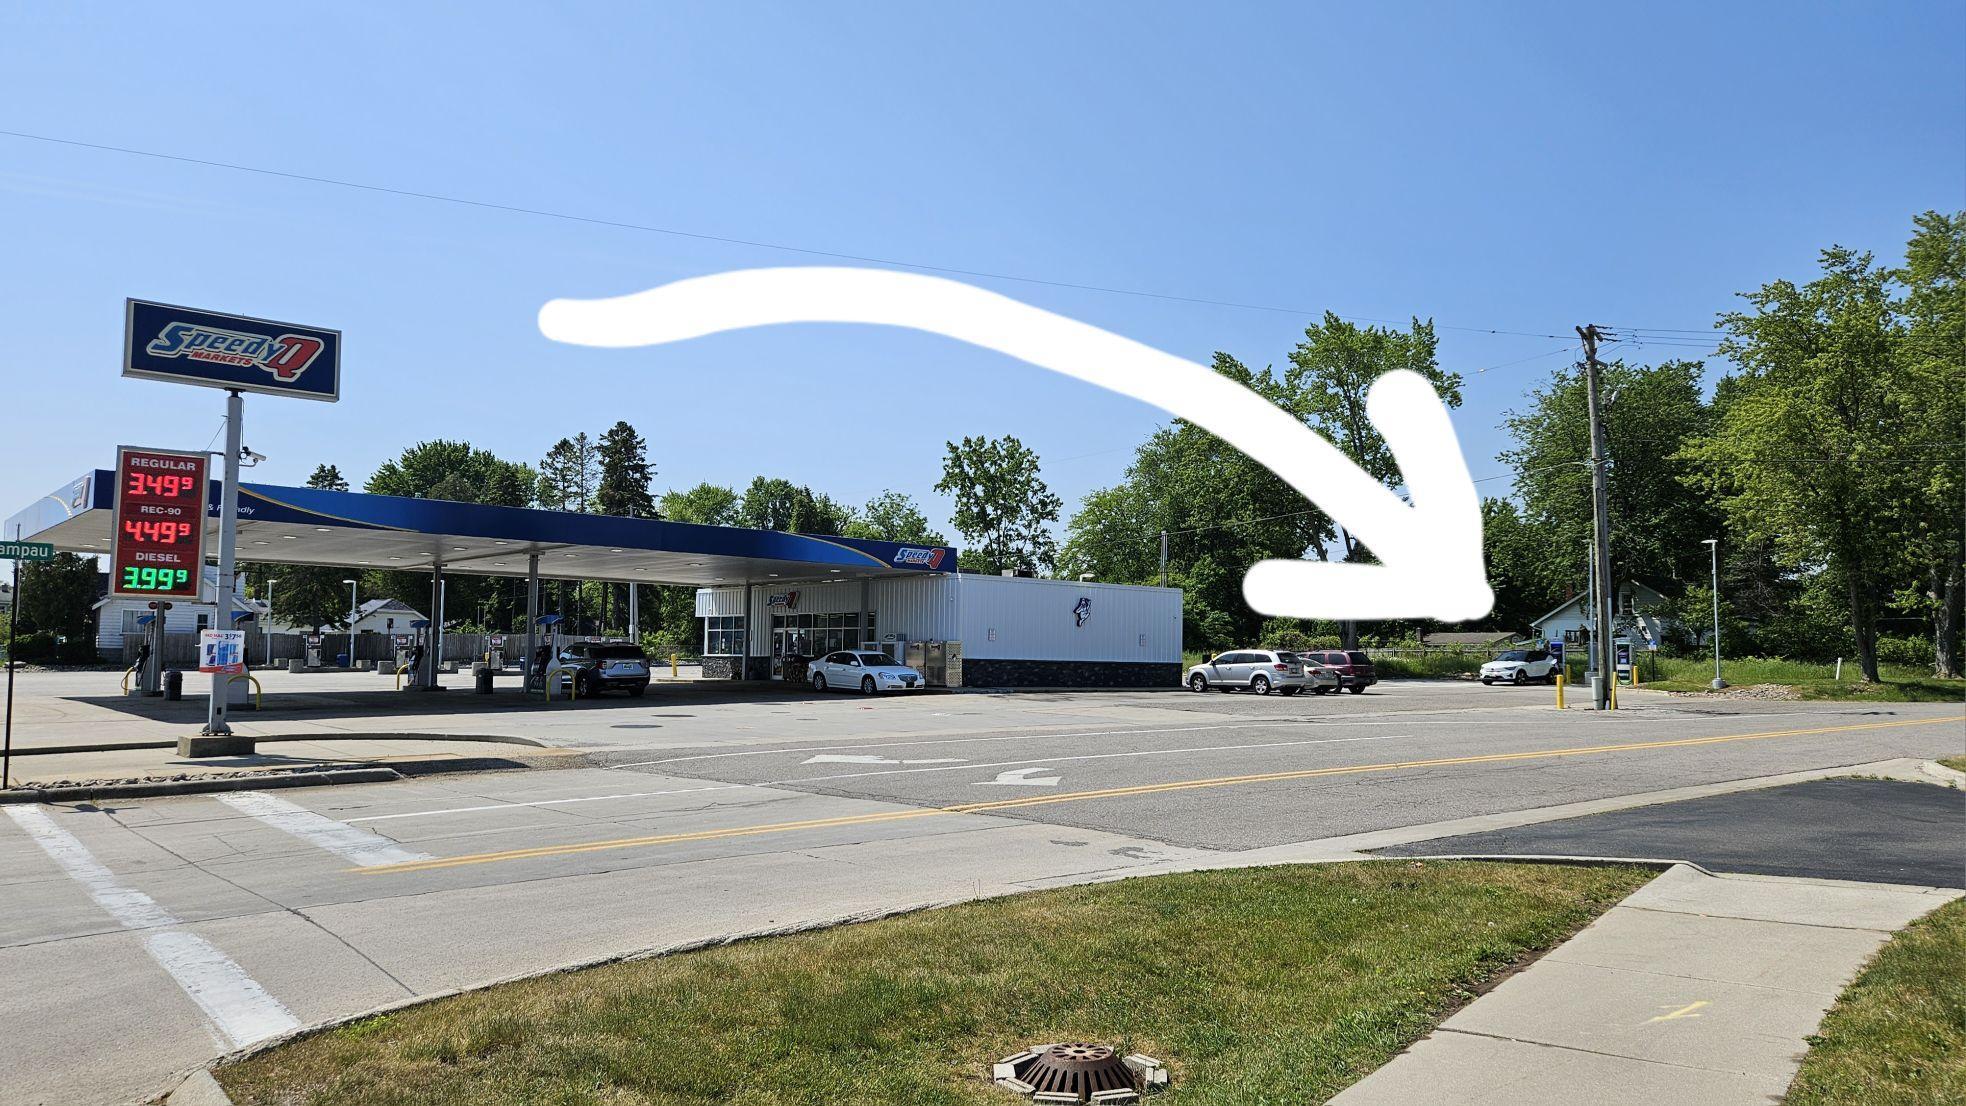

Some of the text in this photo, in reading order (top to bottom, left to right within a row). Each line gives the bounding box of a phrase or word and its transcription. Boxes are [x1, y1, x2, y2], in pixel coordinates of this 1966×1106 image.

[191, 350, 254, 367] MARKETS
[130, 457, 196, 471] REGULAR
[140, 505, 182, 515] REC-90
[0, 544, 48, 558] ampau
[135, 552, 182, 563] DIESEL
